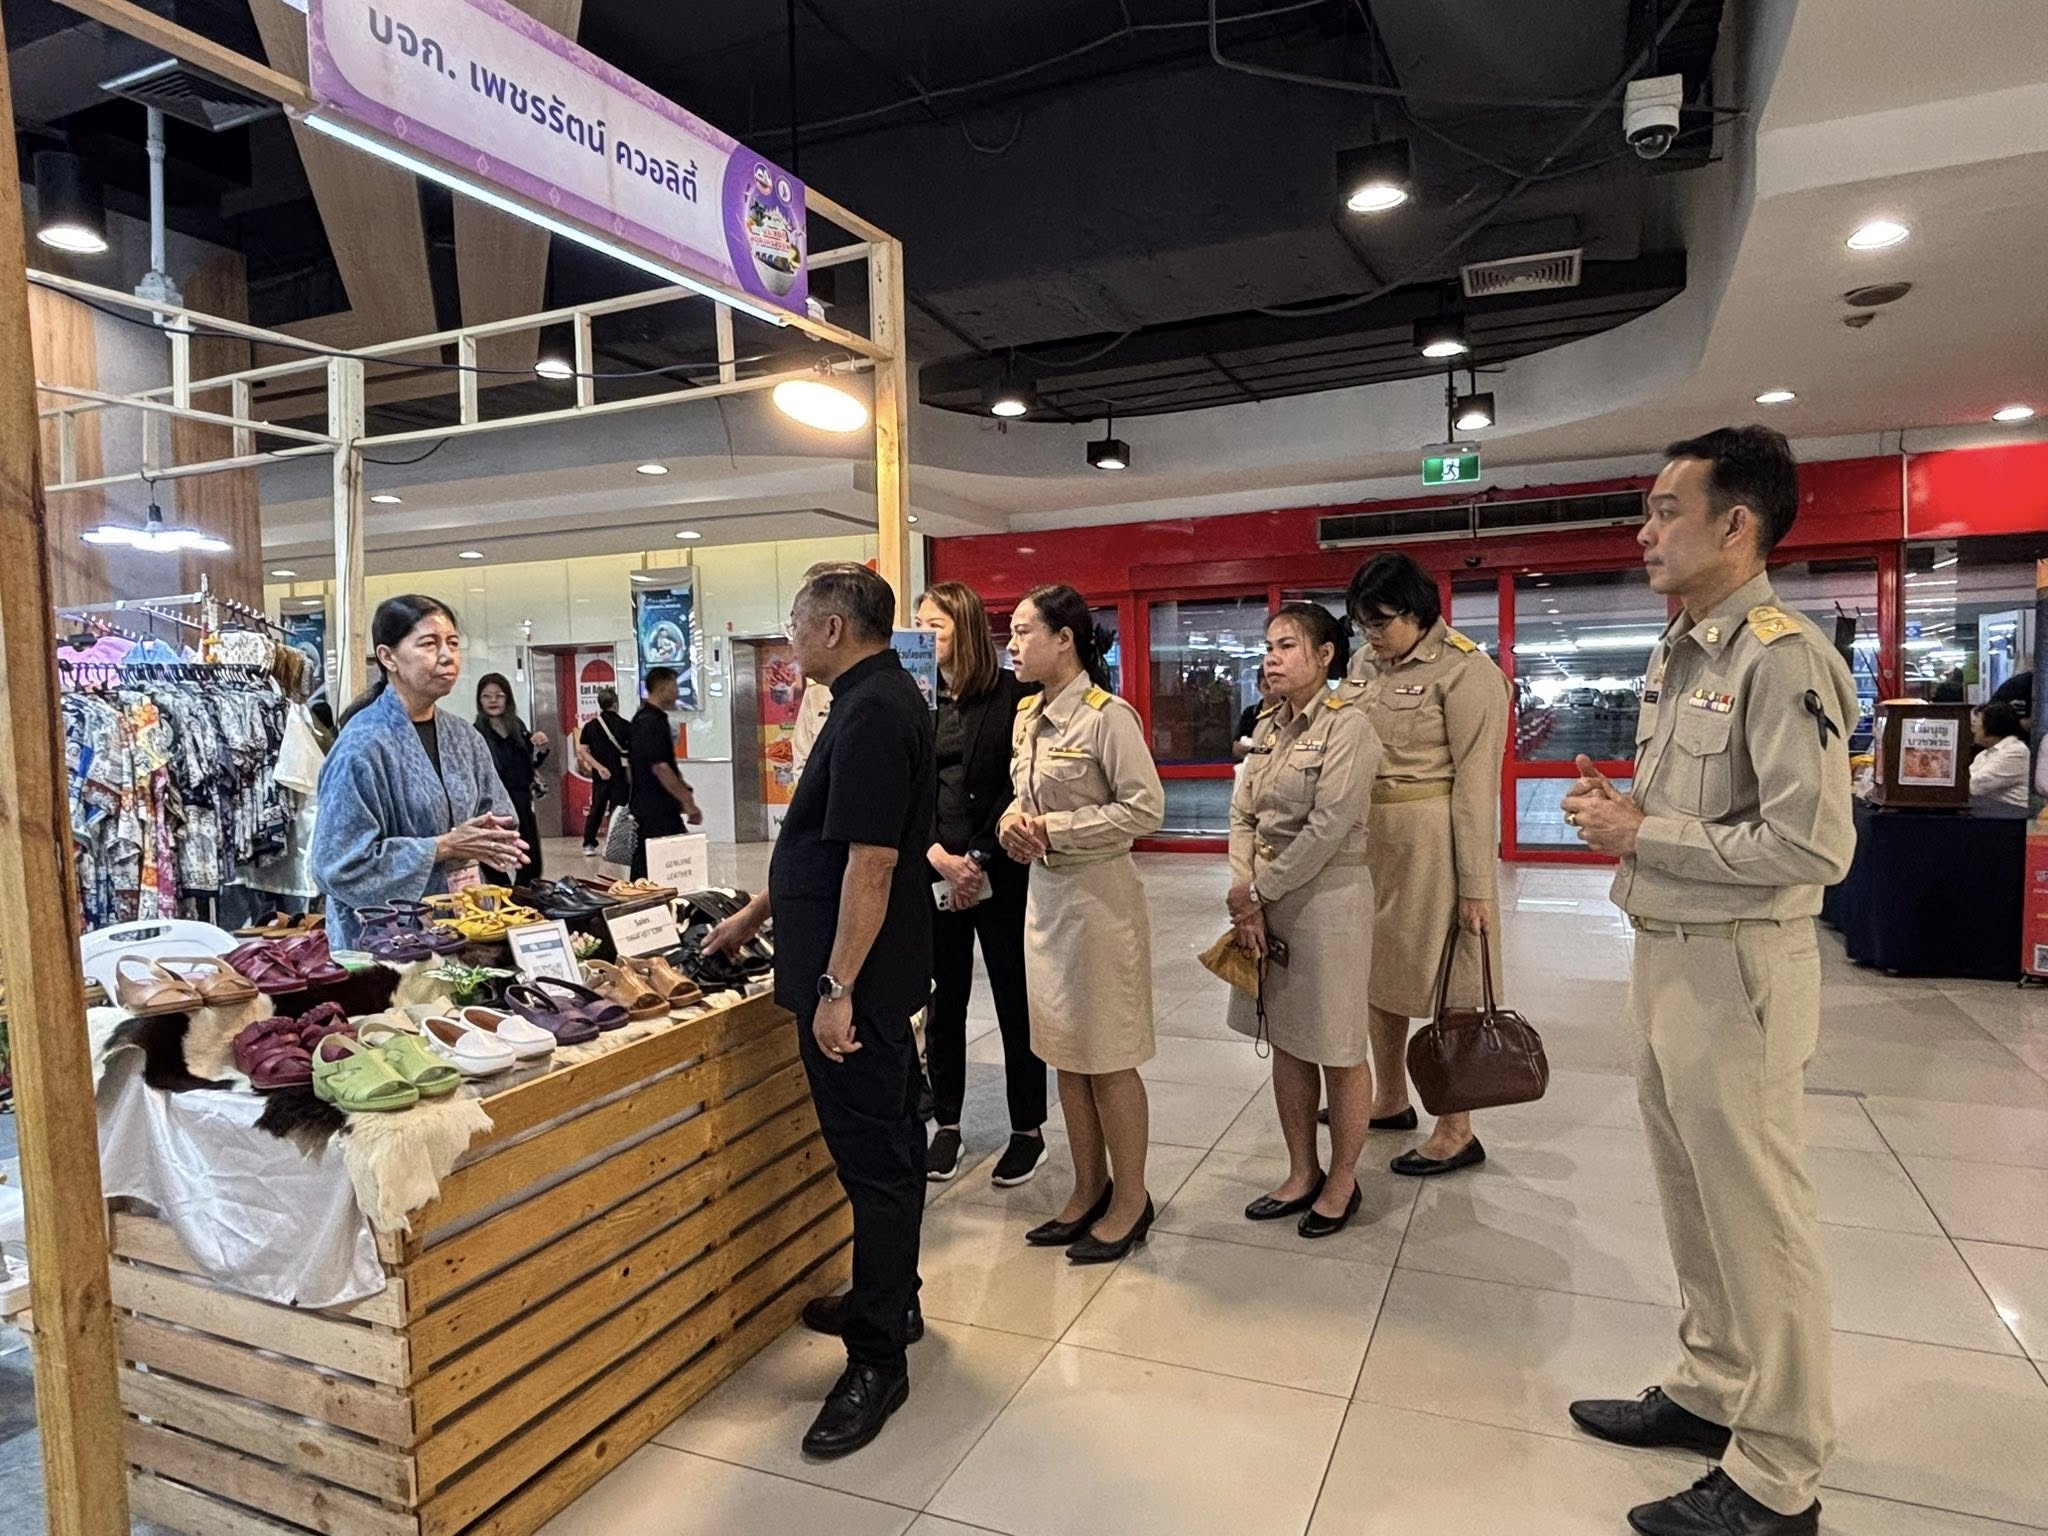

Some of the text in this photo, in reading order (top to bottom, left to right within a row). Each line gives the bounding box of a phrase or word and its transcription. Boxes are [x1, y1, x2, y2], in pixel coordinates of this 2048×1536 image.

[368, 6, 699, 204] บจก. เพชรรัตน์ ควอลิตี้
[665, 856, 692, 868] GENUINE
[666, 869, 693, 881] LEATHER
